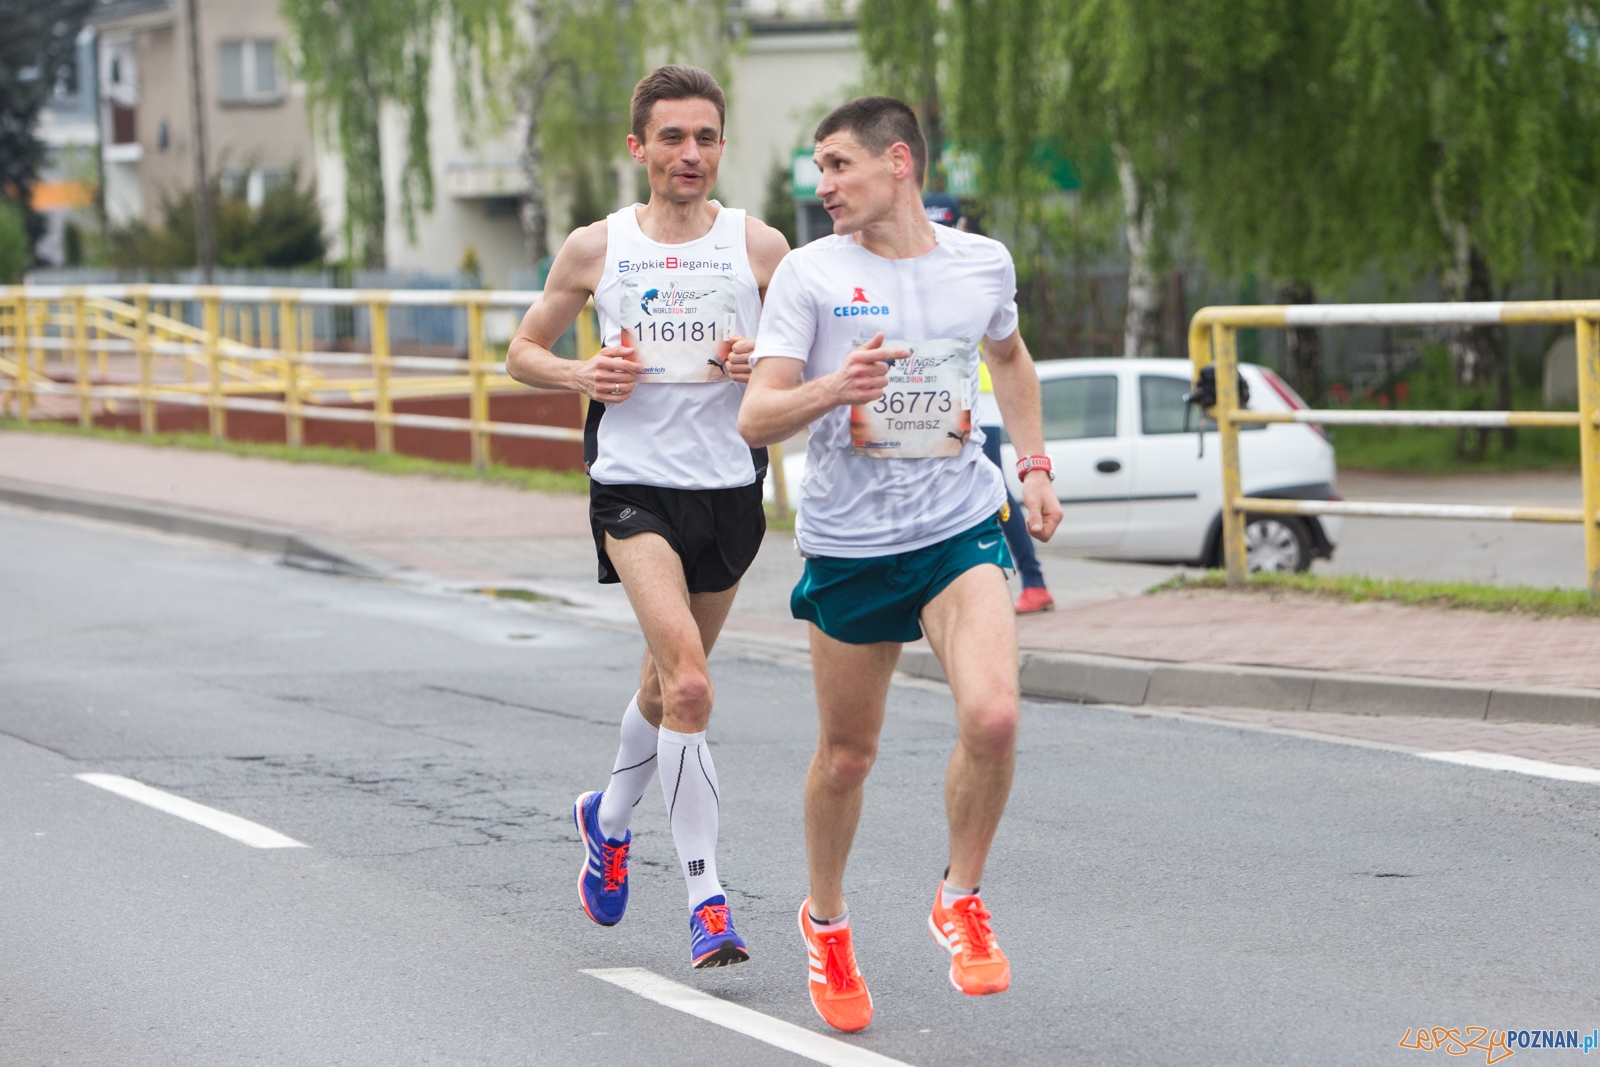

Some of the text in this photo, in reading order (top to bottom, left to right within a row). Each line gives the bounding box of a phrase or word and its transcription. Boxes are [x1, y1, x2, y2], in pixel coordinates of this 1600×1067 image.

[618, 257, 733, 273] SzybkieBieganie.pl
[661, 291, 696, 299] WINGS
[833, 305, 890, 317] CEDROB
[634, 321, 716, 341] 116181
[899, 357, 936, 367] WINGS
[903, 367, 925, 375] LIFE
[923, 375, 937, 383] 2017
[873, 390, 952, 413] 36773
[885, 417, 940, 430] Tomasz
